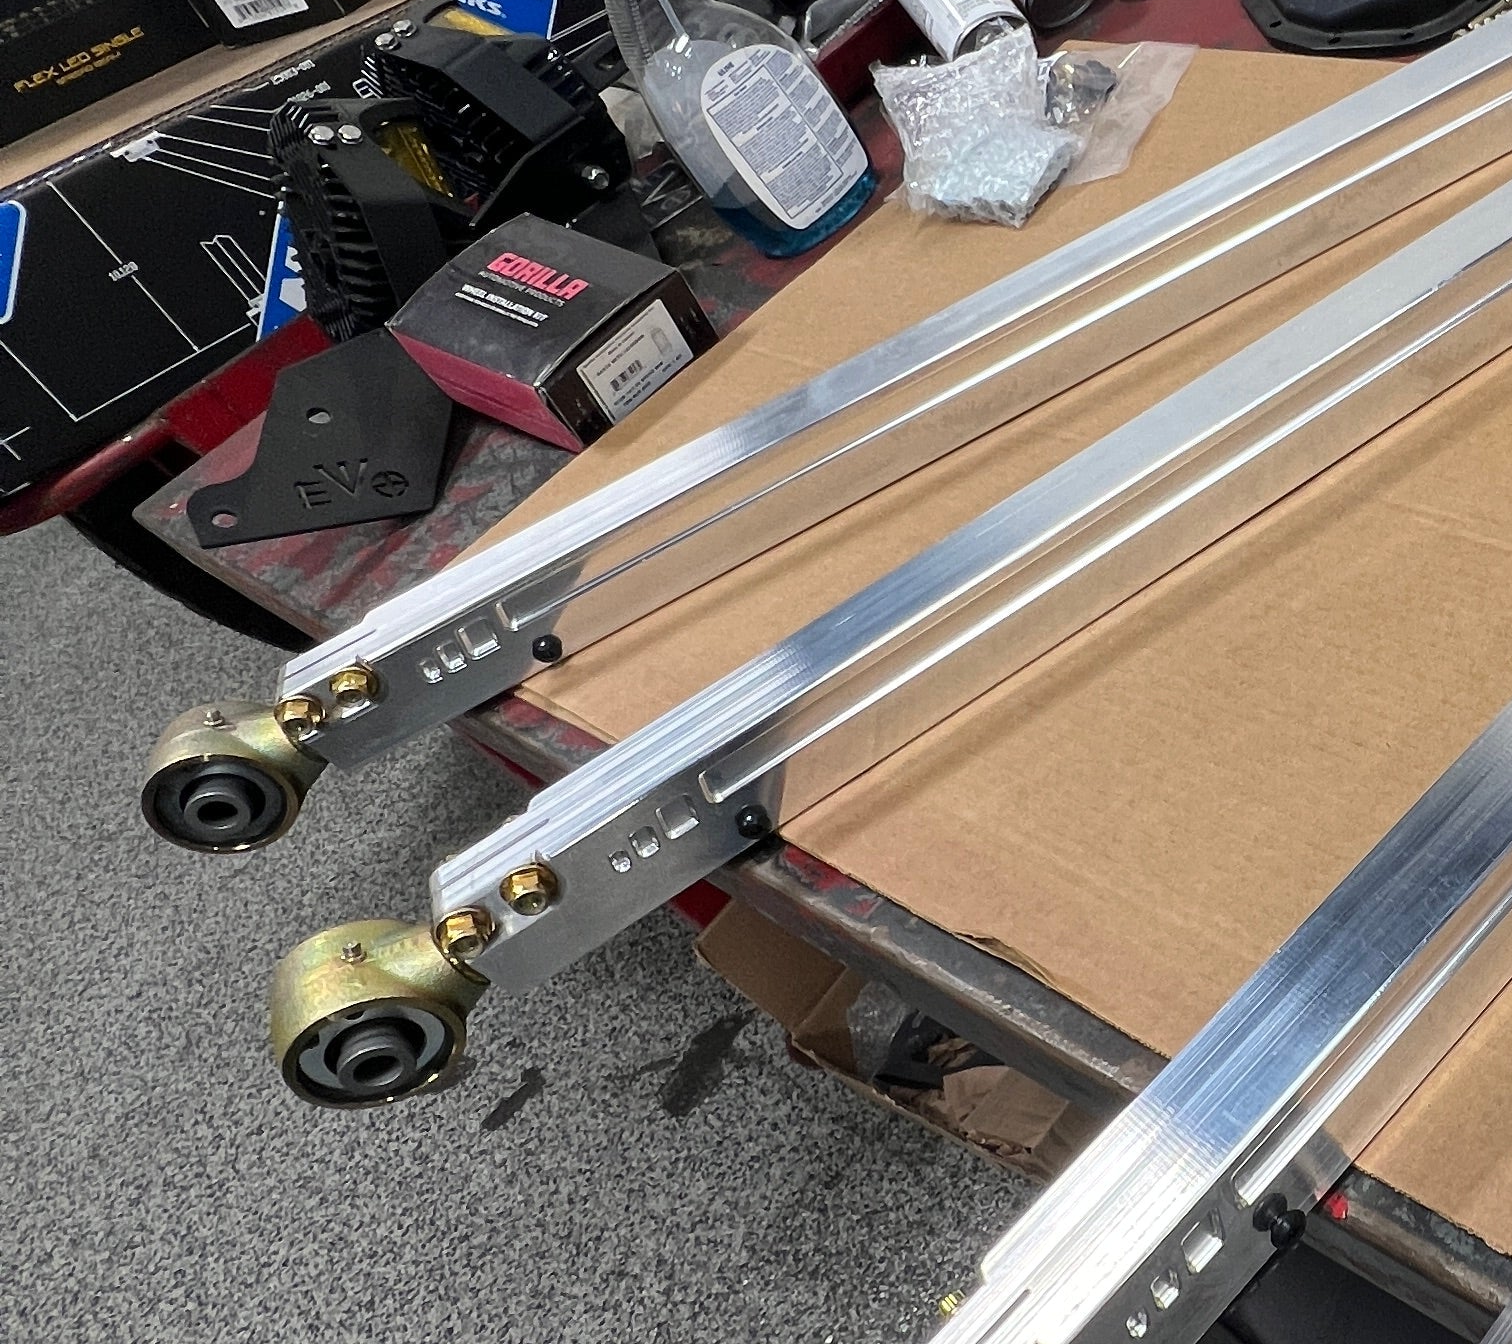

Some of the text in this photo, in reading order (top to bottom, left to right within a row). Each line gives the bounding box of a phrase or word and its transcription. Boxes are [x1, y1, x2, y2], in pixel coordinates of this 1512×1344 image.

[13, 26, 145, 93] FLEX LED SINGLE
[487, 252, 591, 301] GORILLA
